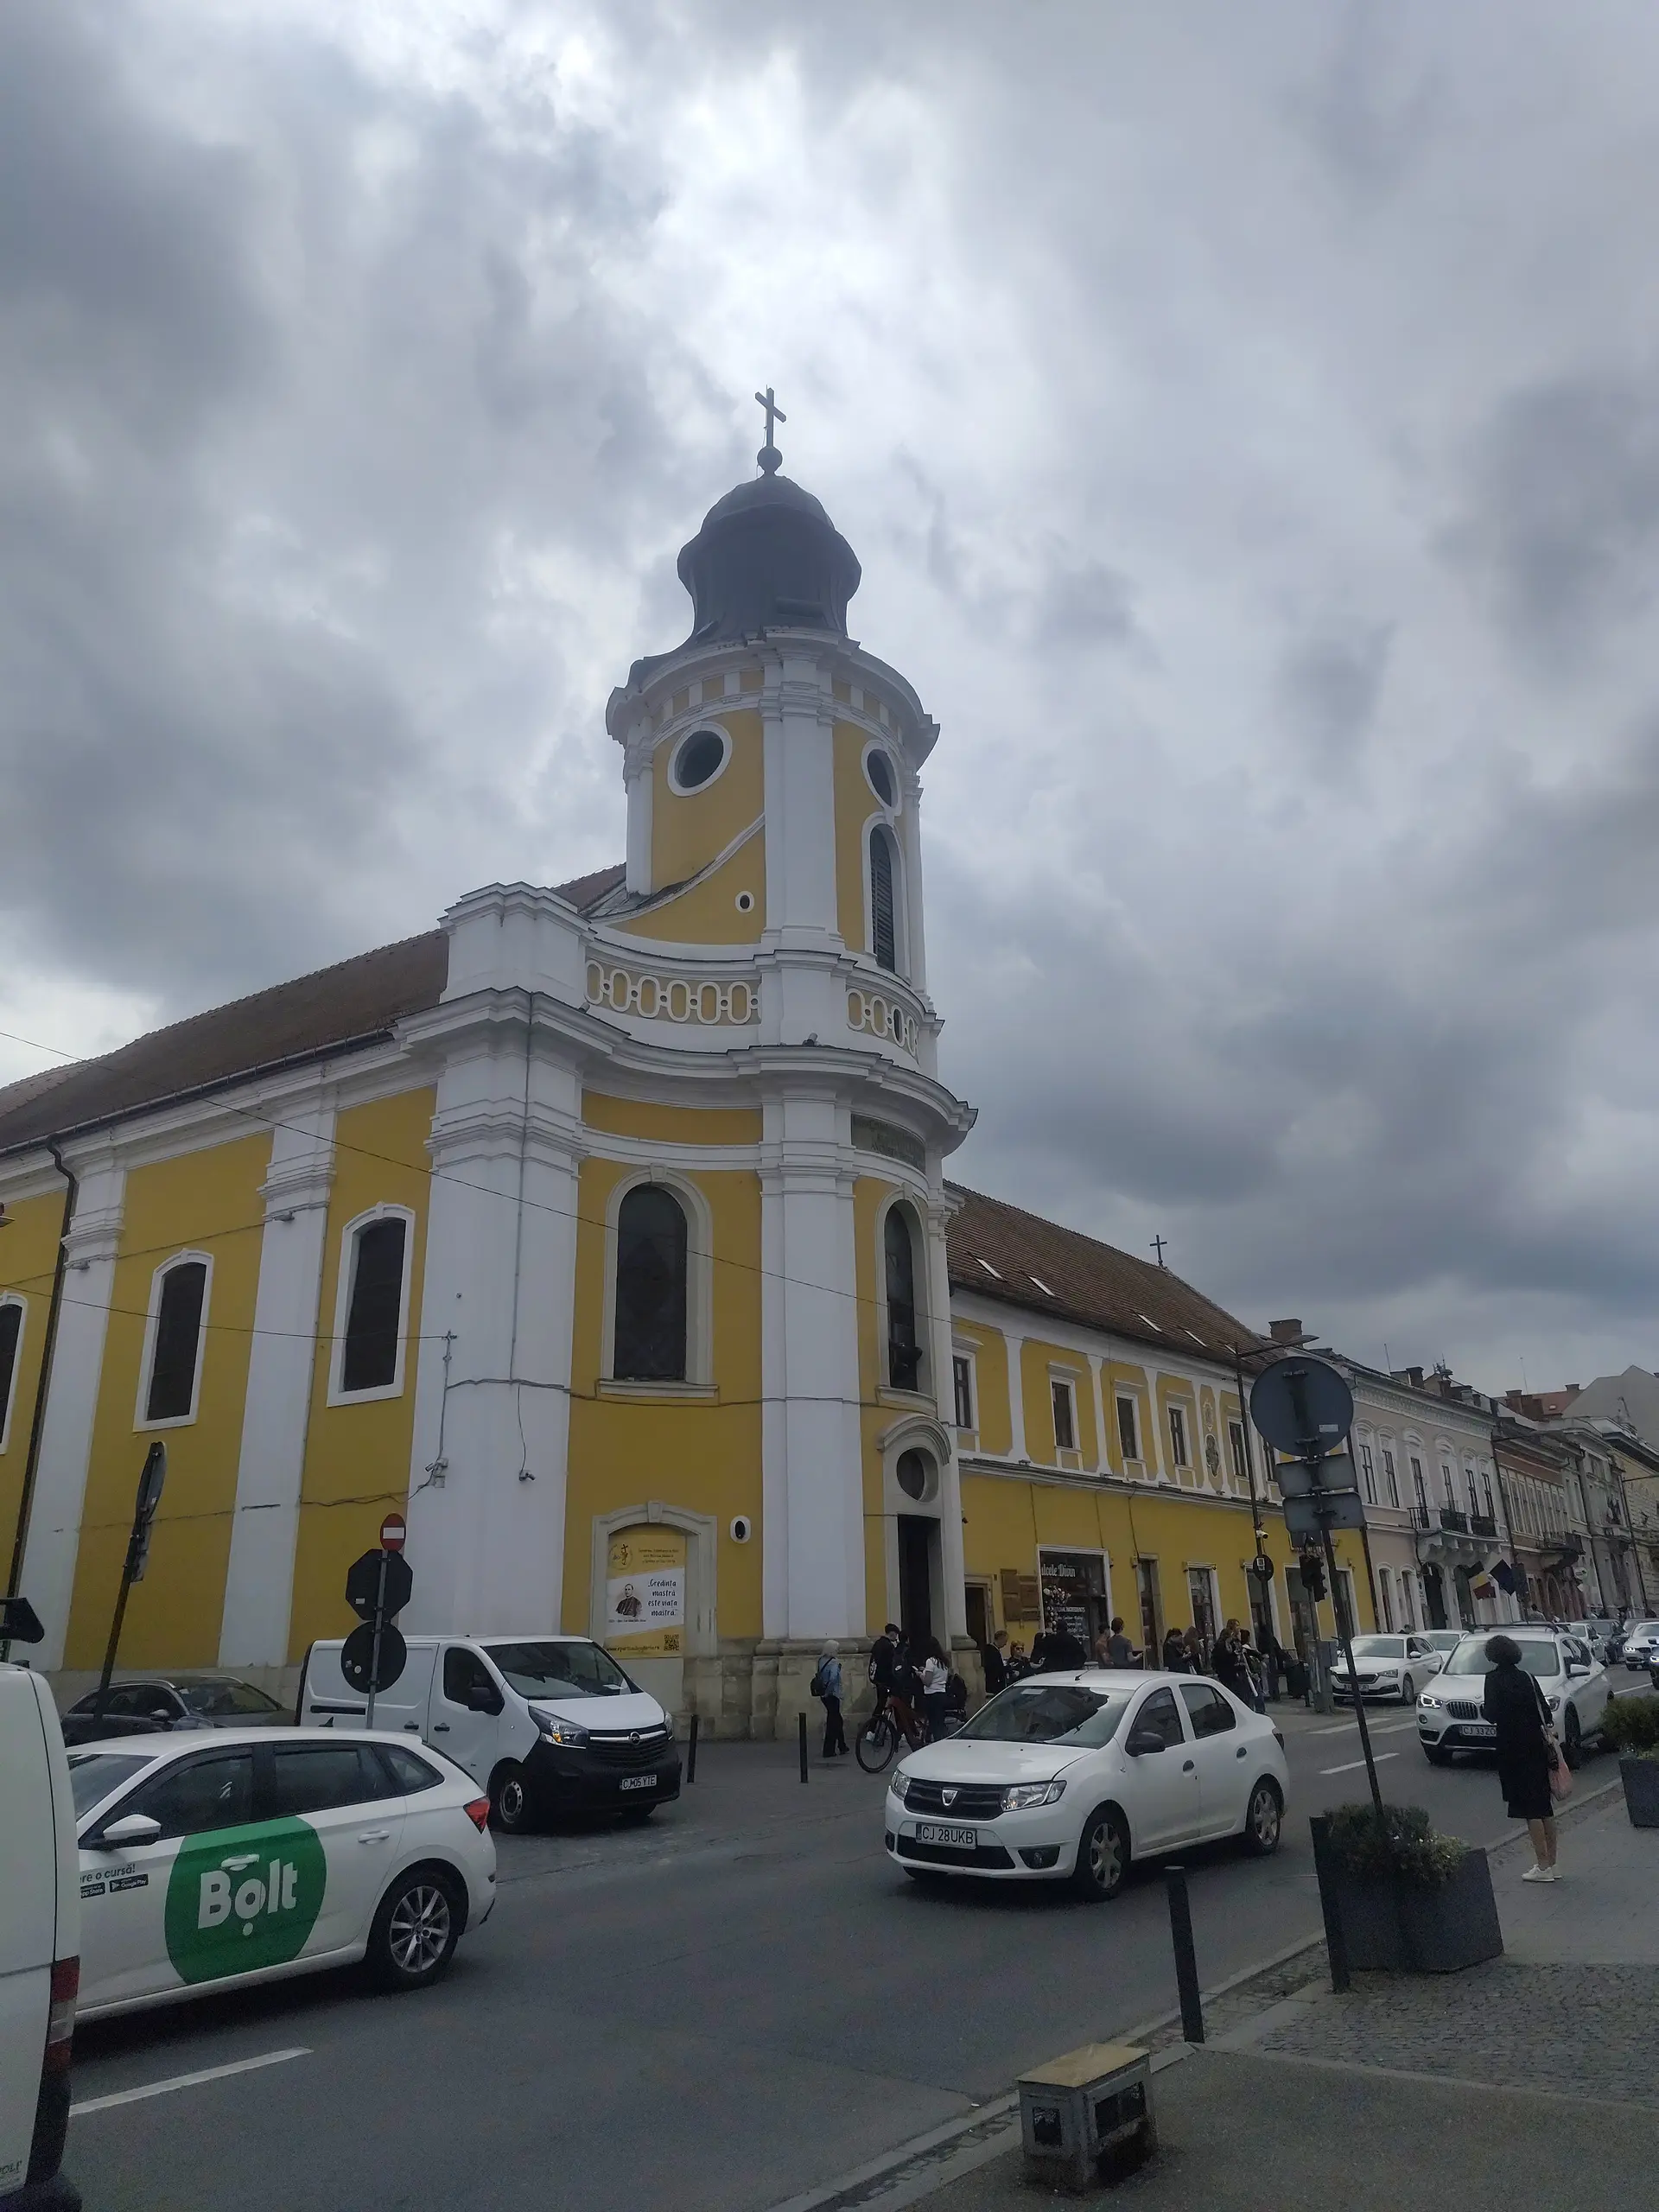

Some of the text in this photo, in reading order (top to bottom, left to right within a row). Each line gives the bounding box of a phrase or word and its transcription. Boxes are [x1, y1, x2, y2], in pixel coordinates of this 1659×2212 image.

[922, 1827, 935, 1840] CJ
[105, 1863, 136, 1878] cursă!
[198, 1859, 297, 1930] Bolt
